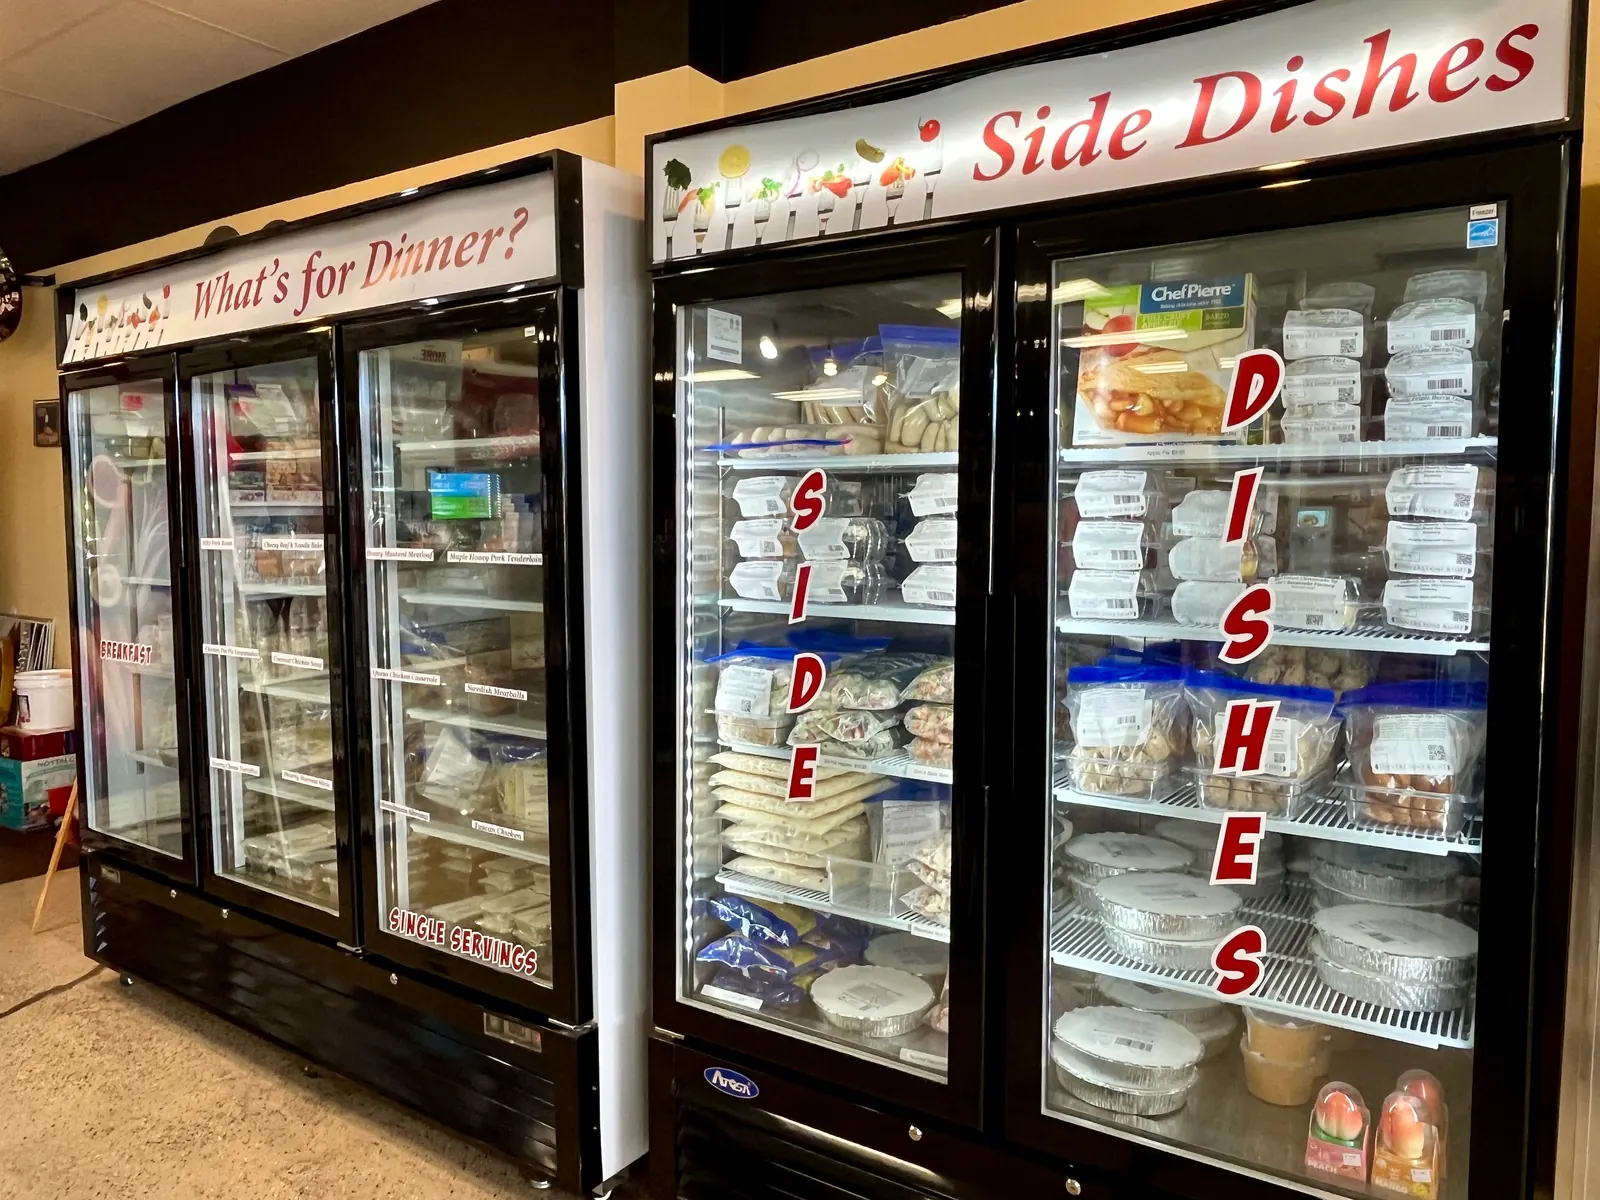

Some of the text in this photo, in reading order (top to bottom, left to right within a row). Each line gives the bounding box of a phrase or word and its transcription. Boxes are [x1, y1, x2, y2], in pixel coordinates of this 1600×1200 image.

[972, 23, 1540, 182] Side Dishes
[194, 206, 529, 321] What's for Dinner?
[384, 550, 408, 558] Mustard
[408, 550, 433, 560] Meatloaf
[449, 553, 542, 563] Maple Honey Pork Tenderloin
[786, 469, 826, 801] SIDE
[101, 640, 152, 665] BREAKFAST
[389, 671, 411, 680] Chicken
[411, 673, 438, 683] Casserole
[1213, 349, 1283, 998] DISHES
[466, 684, 525, 699] Swedish Meatballs
[474, 821, 522, 839] Tuscan Chicken
[389, 906, 538, 976] SINGLE SERVINGS
[1307, 1159, 1337, 1174] PEACH
[1375, 1177, 1409, 1194] MANGO
